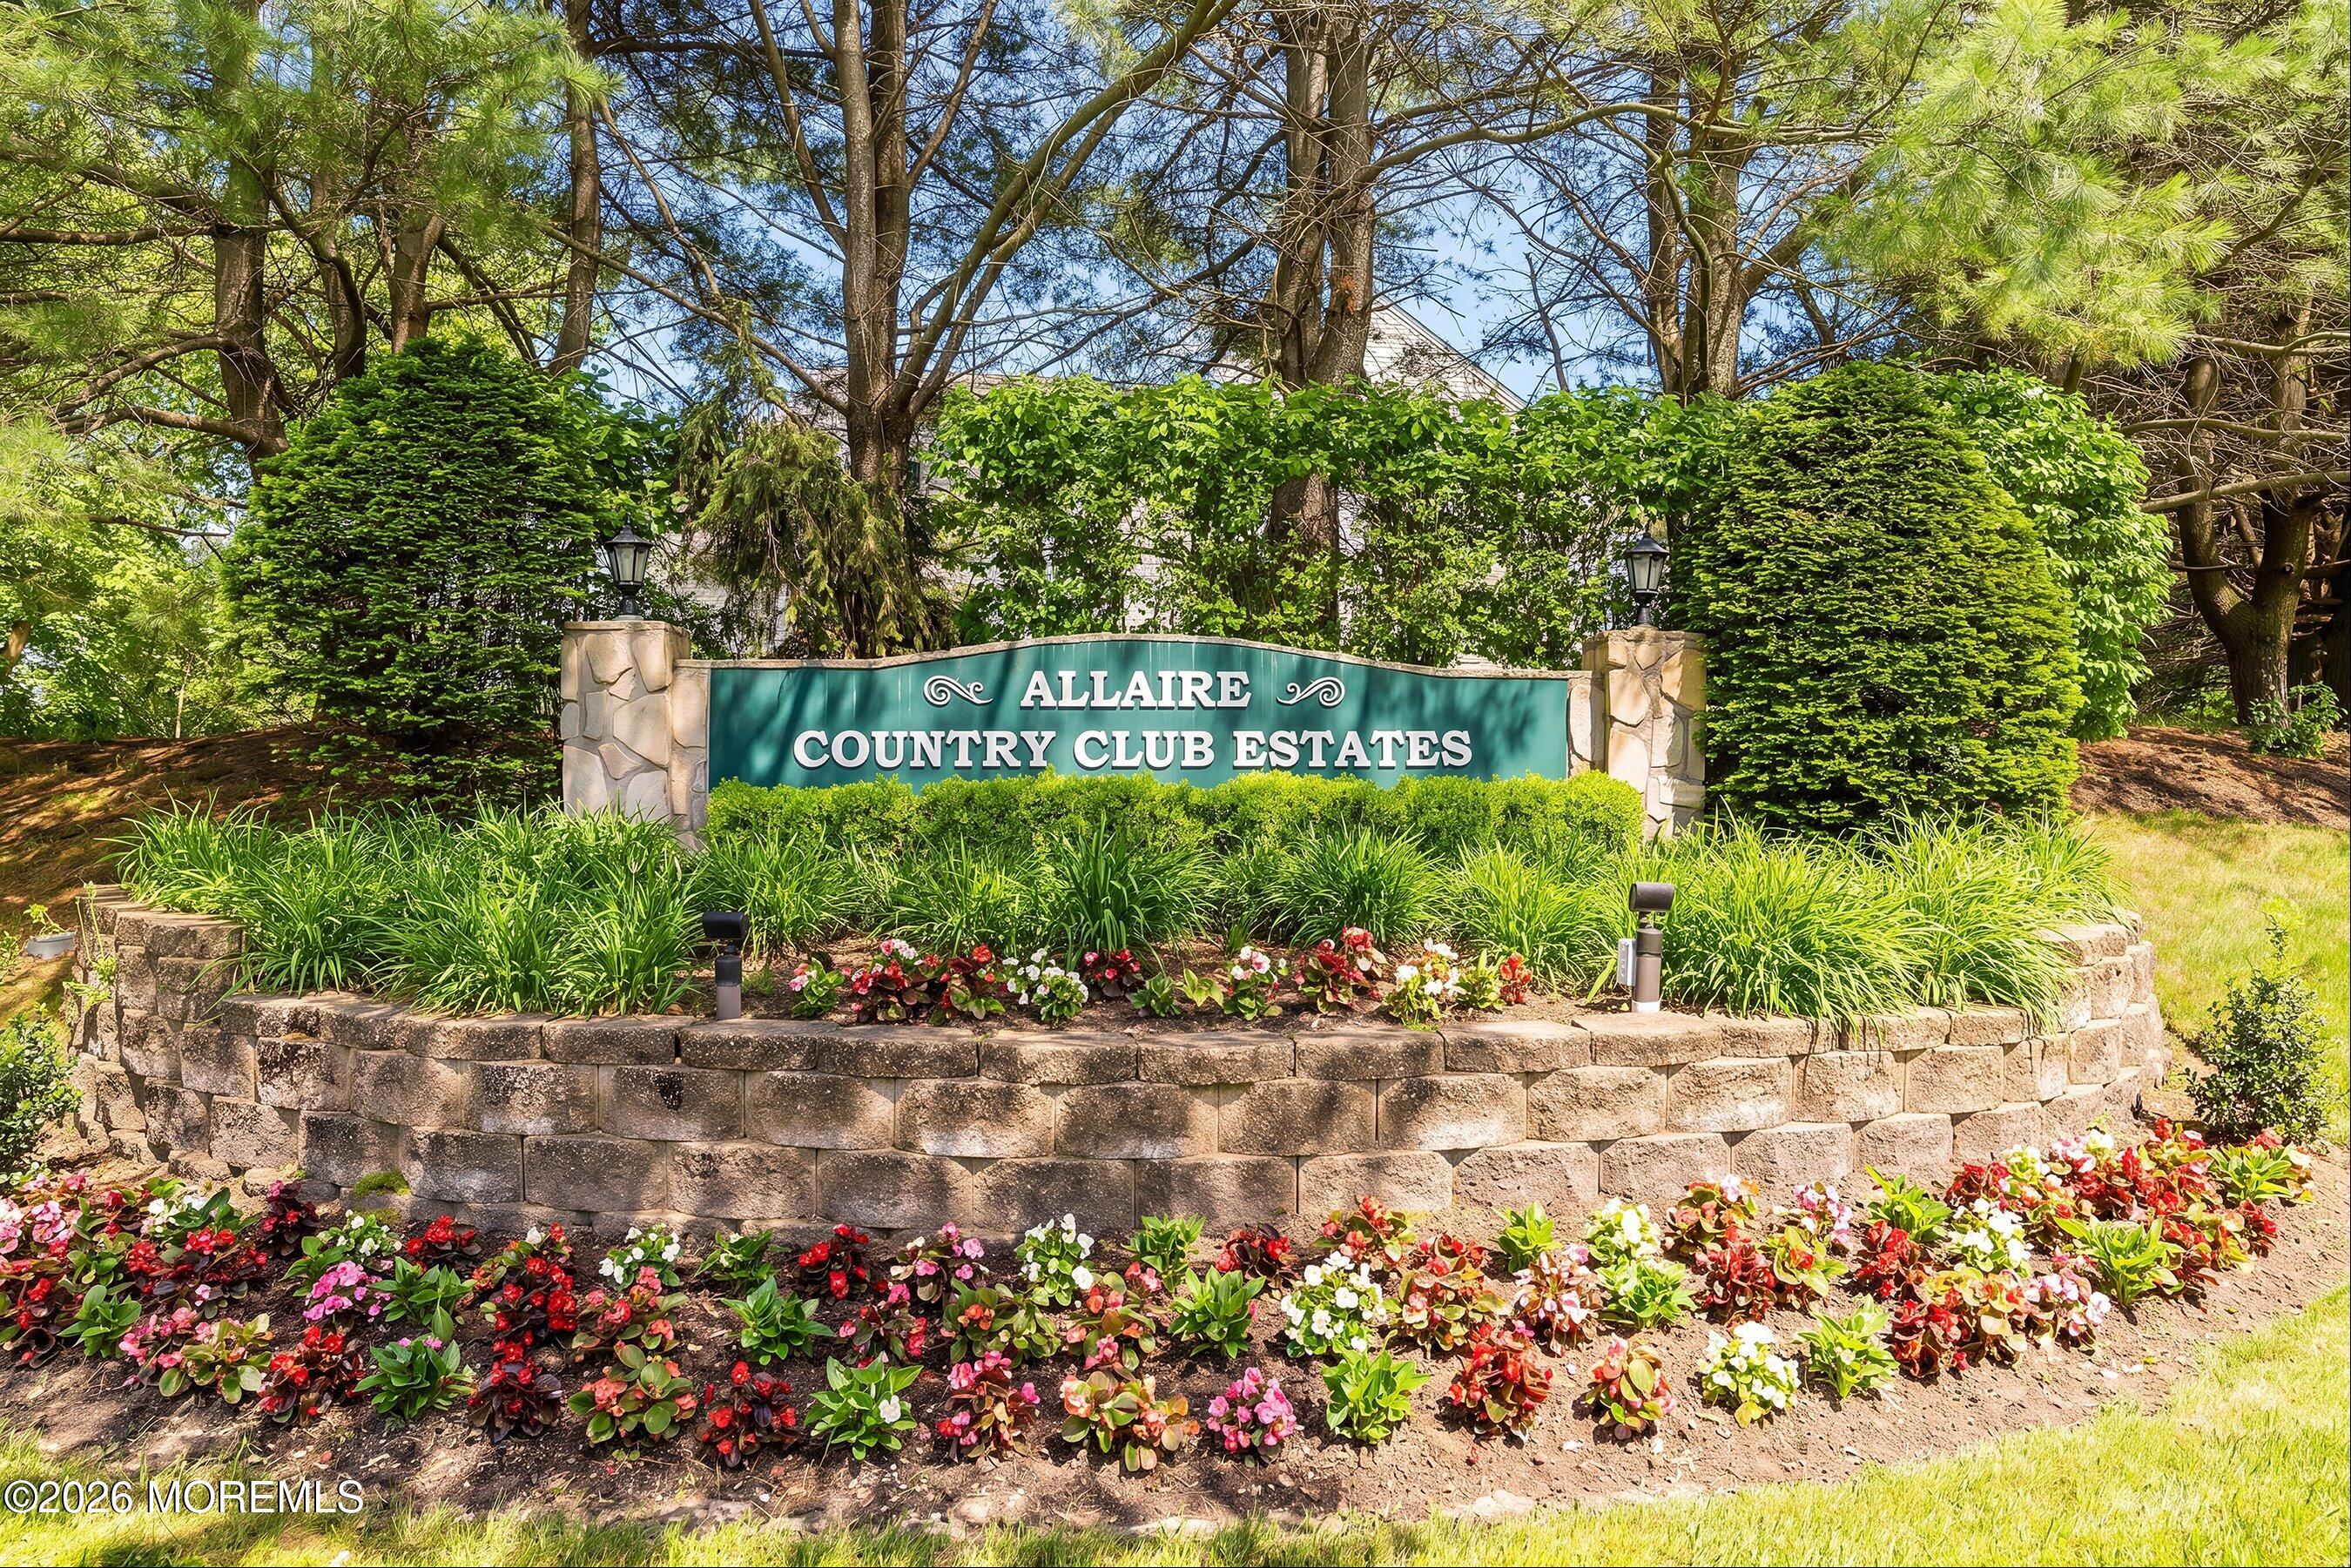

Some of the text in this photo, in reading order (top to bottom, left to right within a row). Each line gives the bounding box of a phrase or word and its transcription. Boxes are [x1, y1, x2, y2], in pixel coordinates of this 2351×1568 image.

[1020, 670, 1252, 709] ALLAIRE
[793, 730, 1473, 769] COUNTRY CLUB ESTATES
